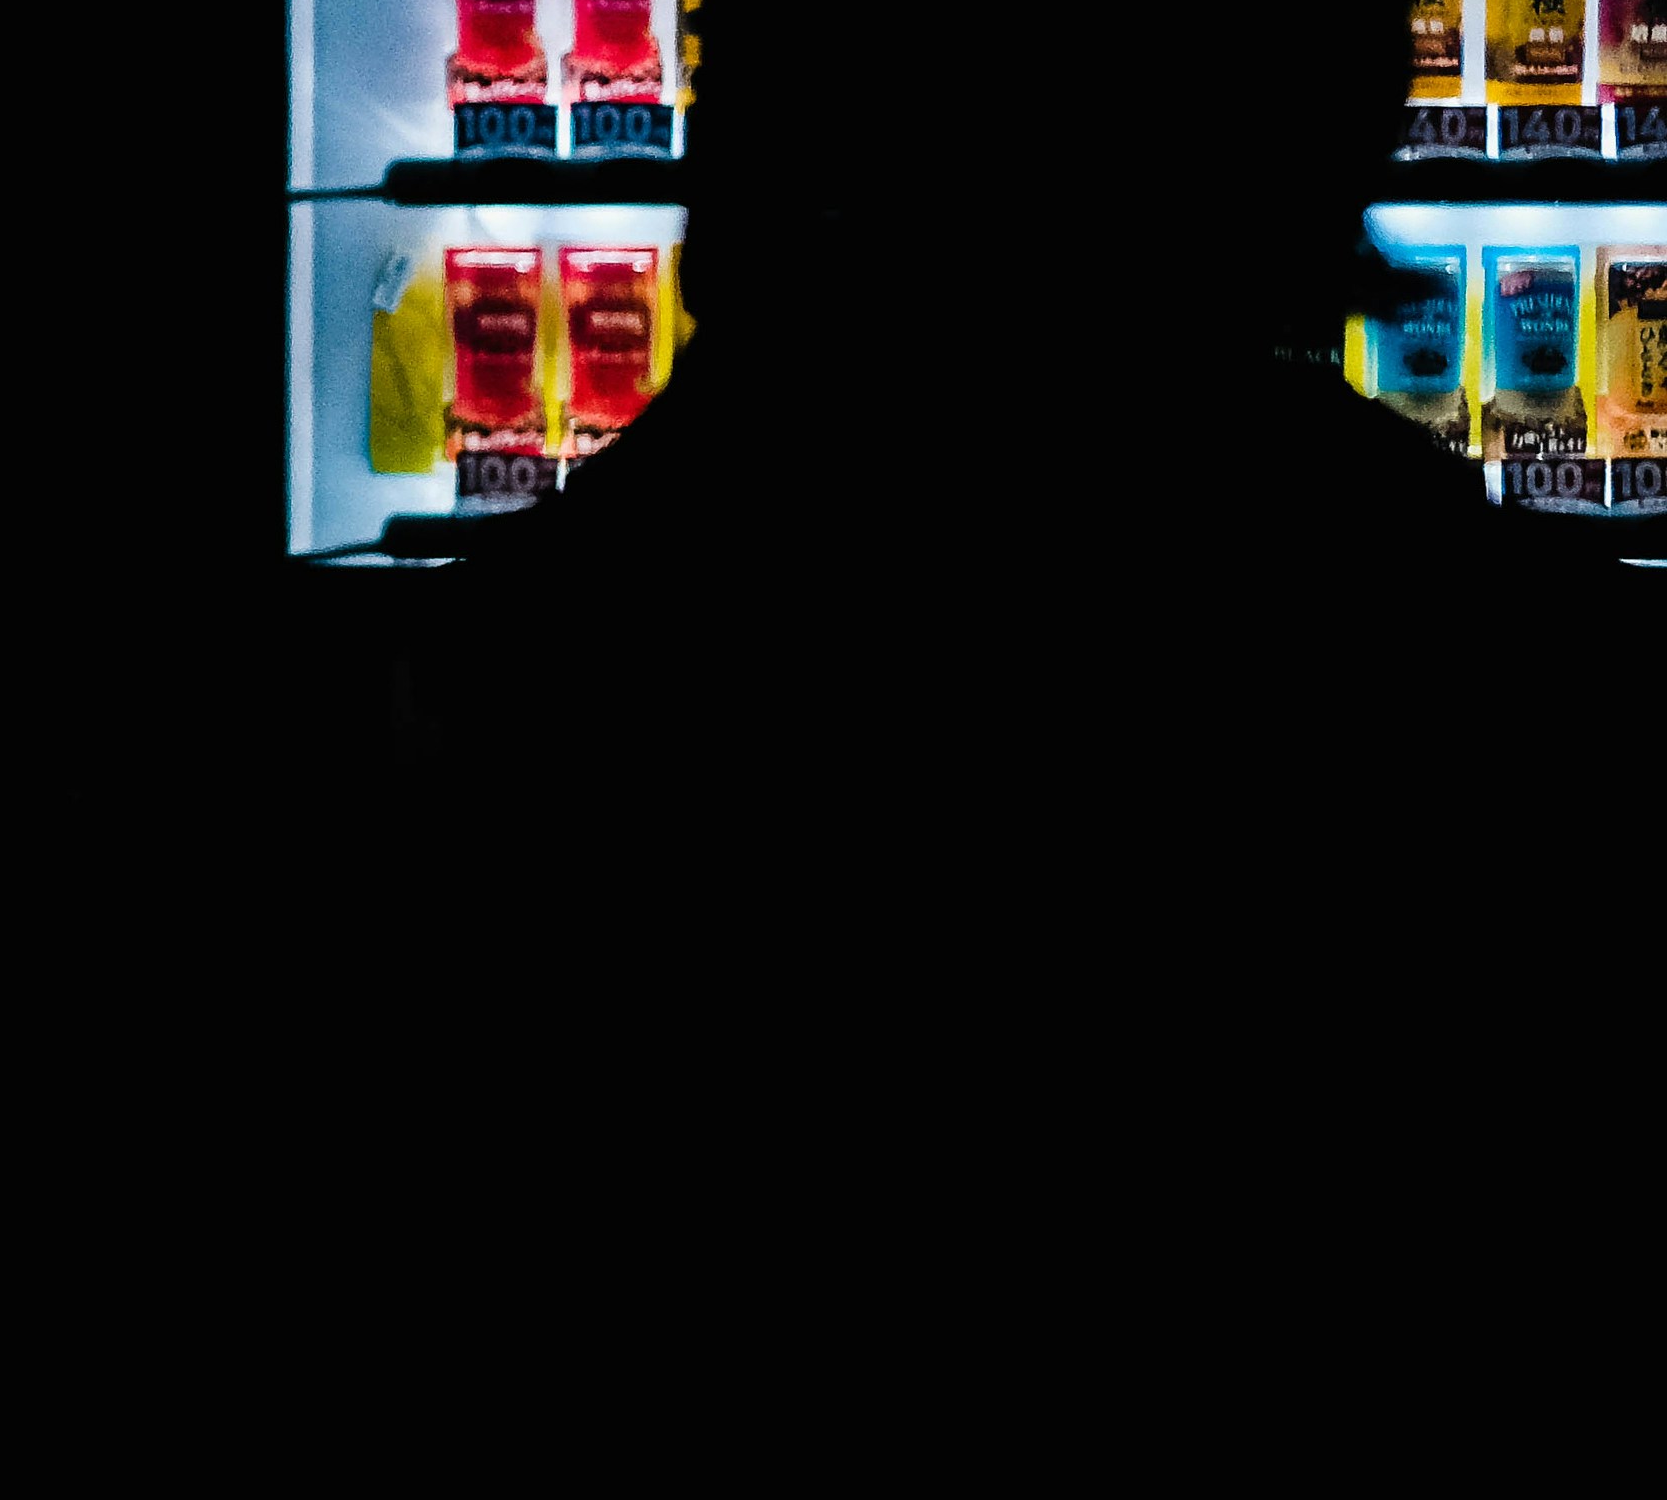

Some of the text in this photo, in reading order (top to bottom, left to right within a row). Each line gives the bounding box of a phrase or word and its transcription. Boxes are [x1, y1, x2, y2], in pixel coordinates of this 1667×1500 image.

[578, 106, 654, 142] 100
[1408, 107, 1467, 145] 40
[1499, 106, 1582, 144] 140
[1505, 461, 1584, 498] 100
